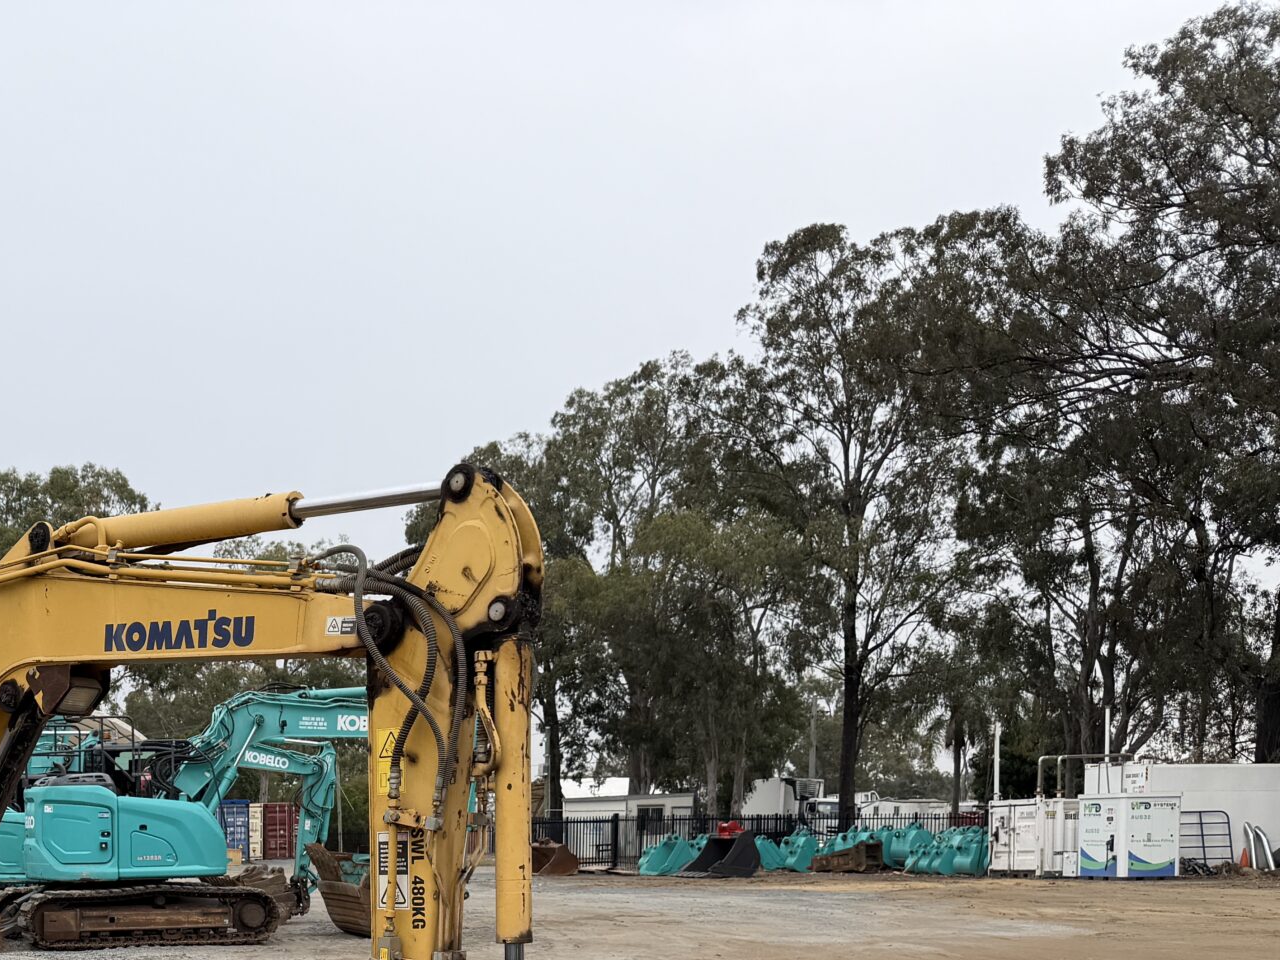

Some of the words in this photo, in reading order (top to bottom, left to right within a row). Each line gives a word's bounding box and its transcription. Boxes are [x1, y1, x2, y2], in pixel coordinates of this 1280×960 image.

[104, 608, 256, 653] KOMATSU
[244, 750, 290, 769] KOBELCO
[411, 828, 425, 864] SWL
[411, 875, 426, 929] 480KG
